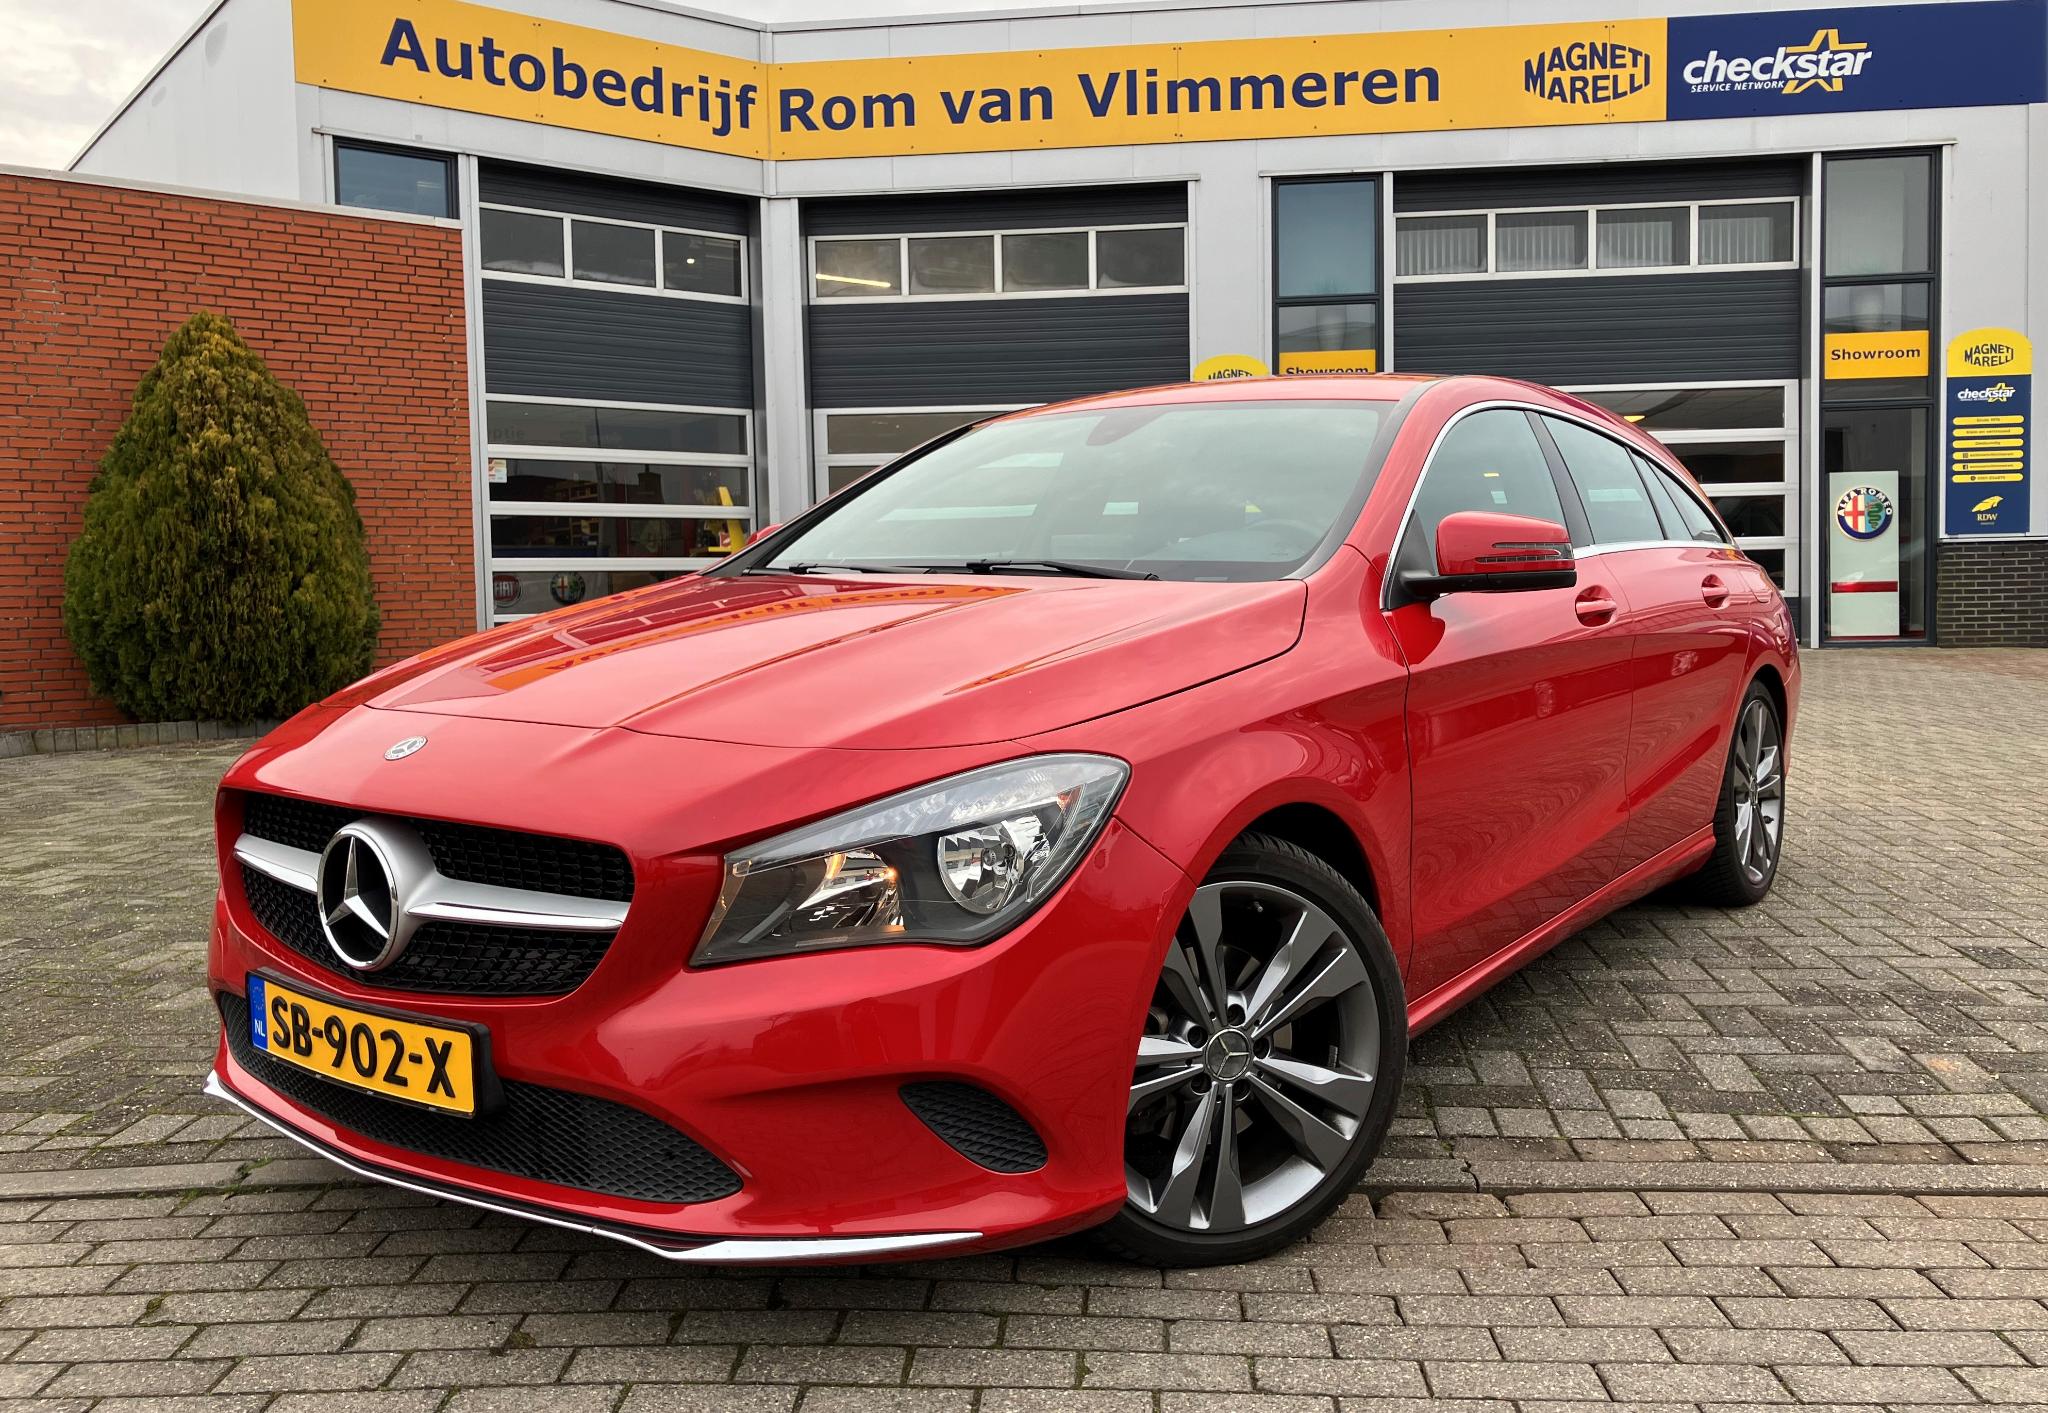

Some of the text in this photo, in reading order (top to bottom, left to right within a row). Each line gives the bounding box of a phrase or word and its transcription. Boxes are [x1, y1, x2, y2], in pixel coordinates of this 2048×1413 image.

[1524, 42, 1650, 82] MAGNETI
[1683, 46, 1873, 85] checkstar
[380, 18, 1440, 136] Autobedrijf Rom van Vlimmeren
[1524, 64, 1650, 104] MARELLI
[1691, 80, 1785, 93] SERVICE NETWORK
[1831, 347, 1921, 361] Showroom
[1964, 343, 2014, 360] MAGNETI
[1964, 351, 2014, 367] MARELLI
[1957, 388, 2016, 399] checkstar
[1838, 488, 1893, 517] ALFA ROMEO
[1977, 513, 1998, 521] RDW
[254, 1018, 266, 1039] NL
[272, 996, 456, 1099] SB-902-X
